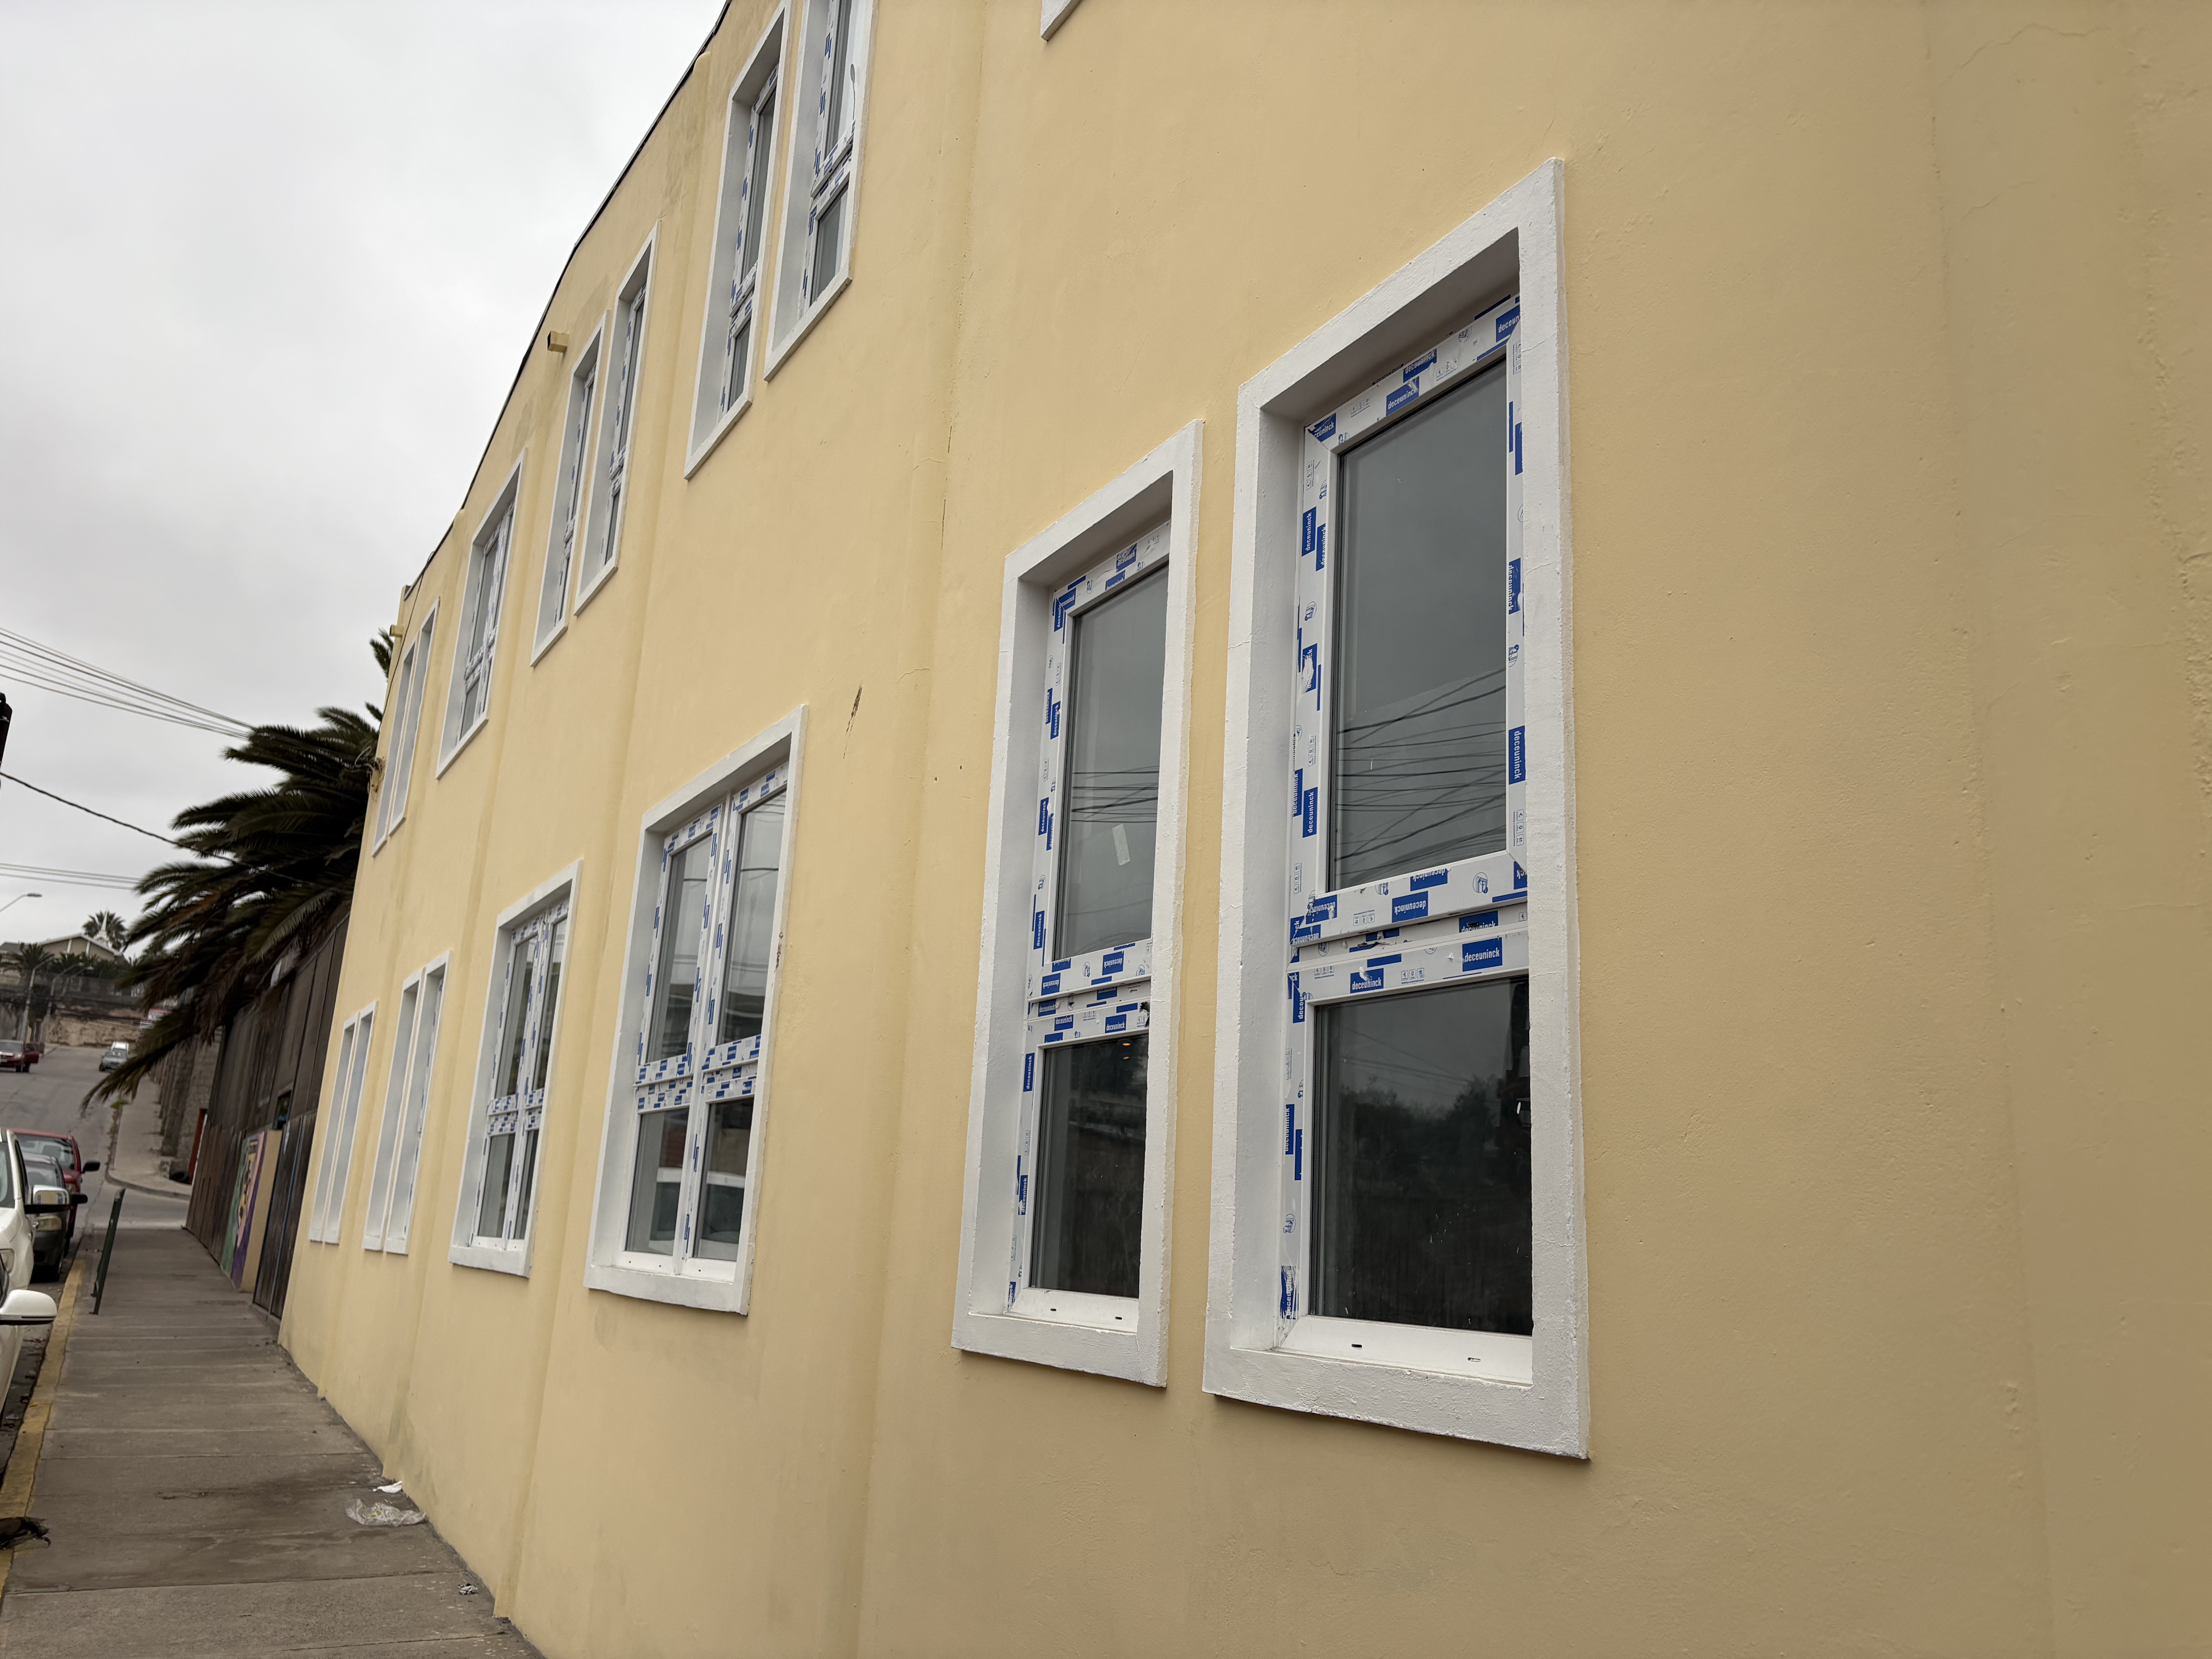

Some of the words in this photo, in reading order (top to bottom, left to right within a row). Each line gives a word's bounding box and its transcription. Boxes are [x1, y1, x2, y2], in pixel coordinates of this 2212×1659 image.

[1499, 315, 1520, 333] deceun
[1395, 900, 1426, 915] deceuninck
[1465, 948, 1500, 962] deceuninck
[1352, 976, 1381, 990] deceuninck
